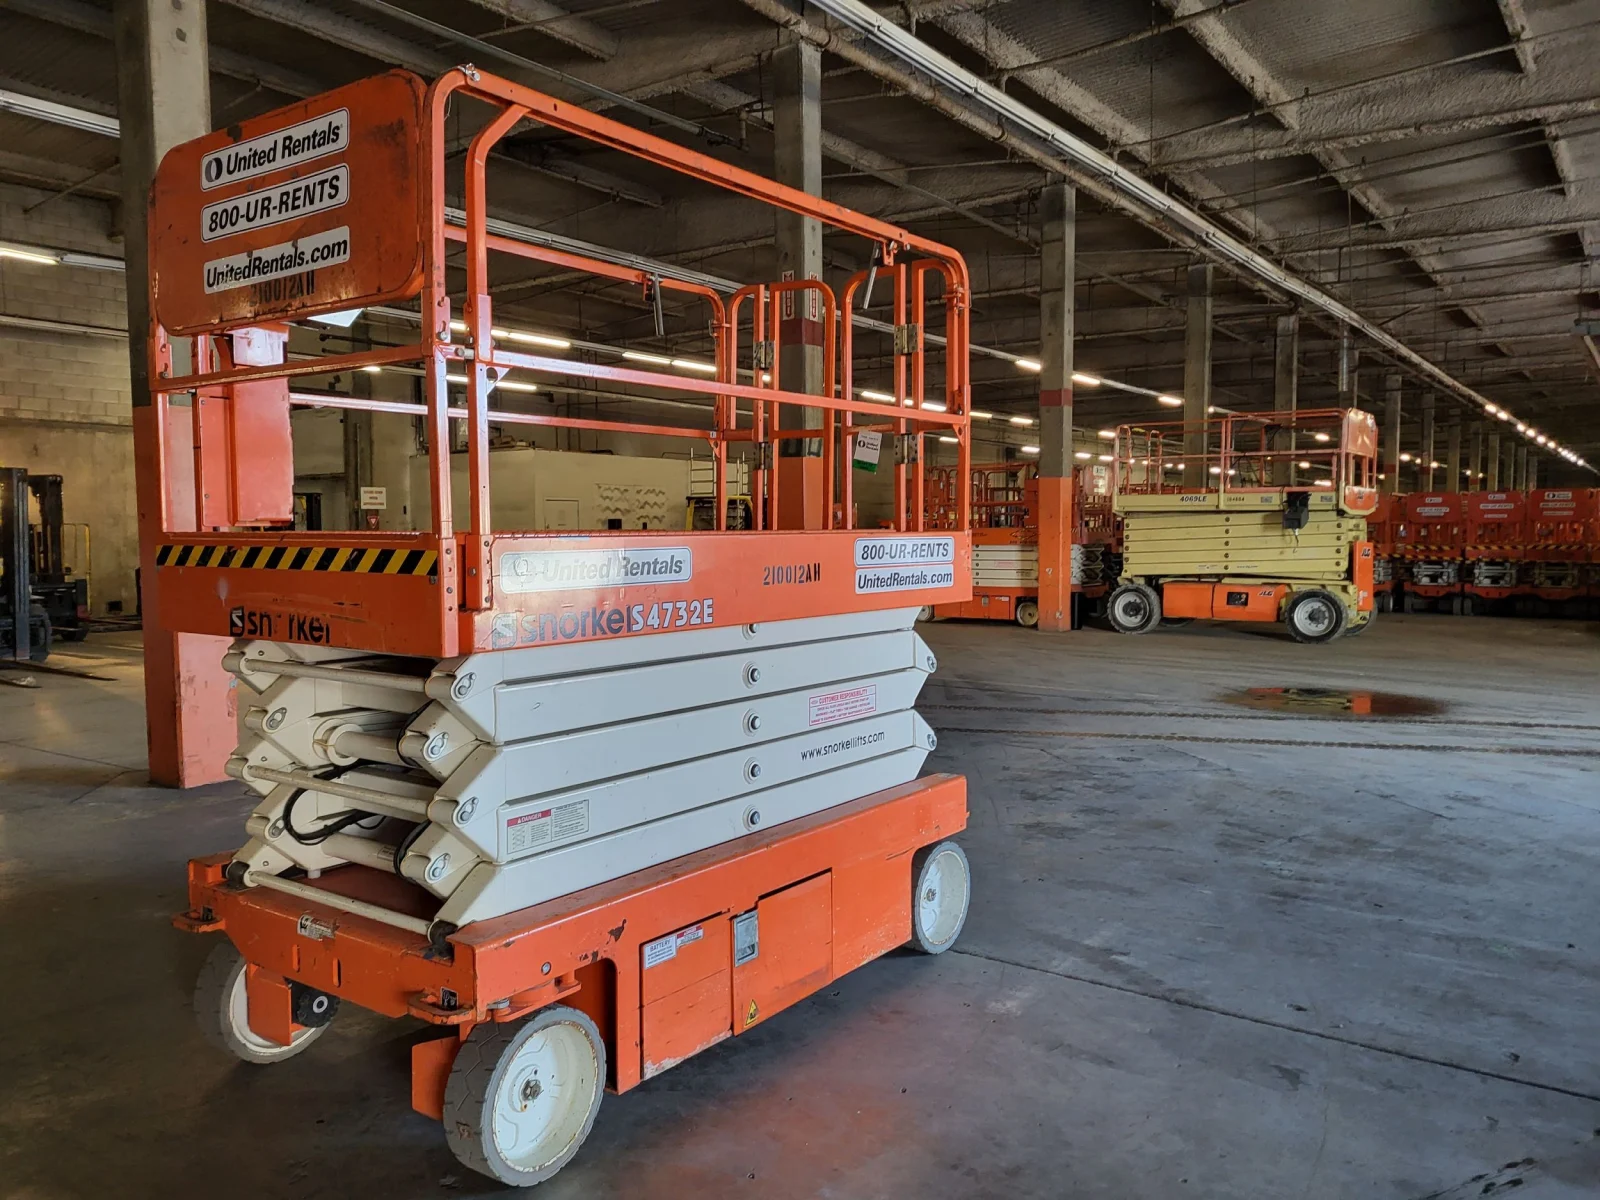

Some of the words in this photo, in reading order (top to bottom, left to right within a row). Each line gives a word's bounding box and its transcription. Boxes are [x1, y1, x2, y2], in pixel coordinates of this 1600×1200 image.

[226, 140, 277, 175] United
[281, 121, 340, 159] Rentals
[209, 175, 340, 232] 800-UR-RENTS
[206, 239, 347, 288] UnitedRentals.com
[861, 543, 949, 560] 800-UR-RENTS
[543, 557, 611, 582] United
[616, 554, 682, 577] Rentals
[763, 562, 821, 585] 210012AH
[857, 571, 952, 589] UnitedRentals.com
[521, 605, 632, 644] snorkel
[632, 598, 714, 632] S4732E
[819, 694, 839, 705] CUSTOMER
[839, 689, 868, 700] RESPONSIBILITY
[801, 731, 885, 761] www.snorkellifts.com
[521, 812, 542, 823] DANGER
[650, 939, 671, 952] BATTERY
